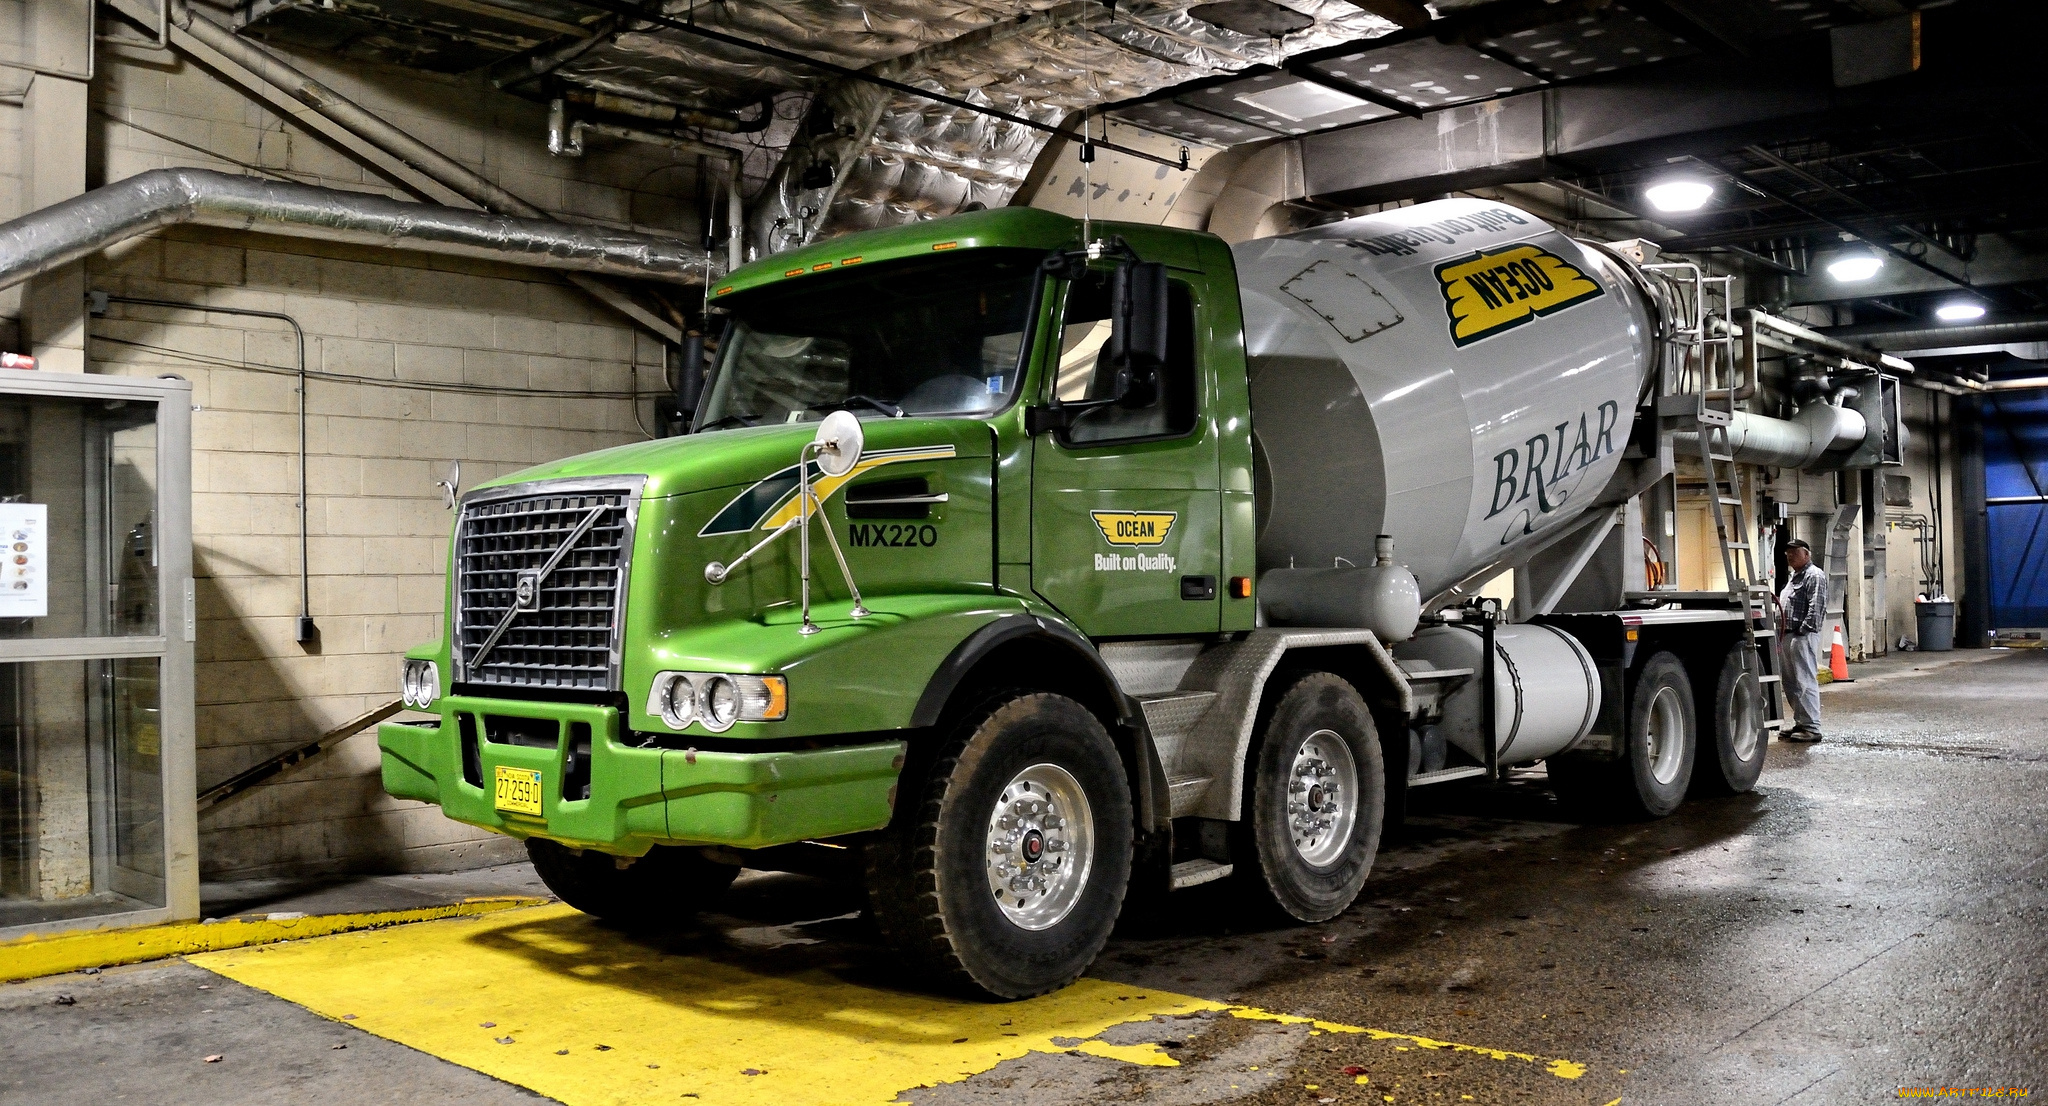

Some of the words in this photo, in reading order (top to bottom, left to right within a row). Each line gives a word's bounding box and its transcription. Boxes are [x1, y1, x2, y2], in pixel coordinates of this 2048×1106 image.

[1431, 219, 1475, 236] on
[1456, 208, 1529, 232] Built
[1464, 258, 1554, 310] OCEAN
[1483, 400, 1618, 544] BRIAR
[1116, 520, 1155, 537] OCEAN
[1094, 553, 1121, 571] Built
[1122, 556, 1137, 570] on
[1137, 553, 1177, 574] Quality.
